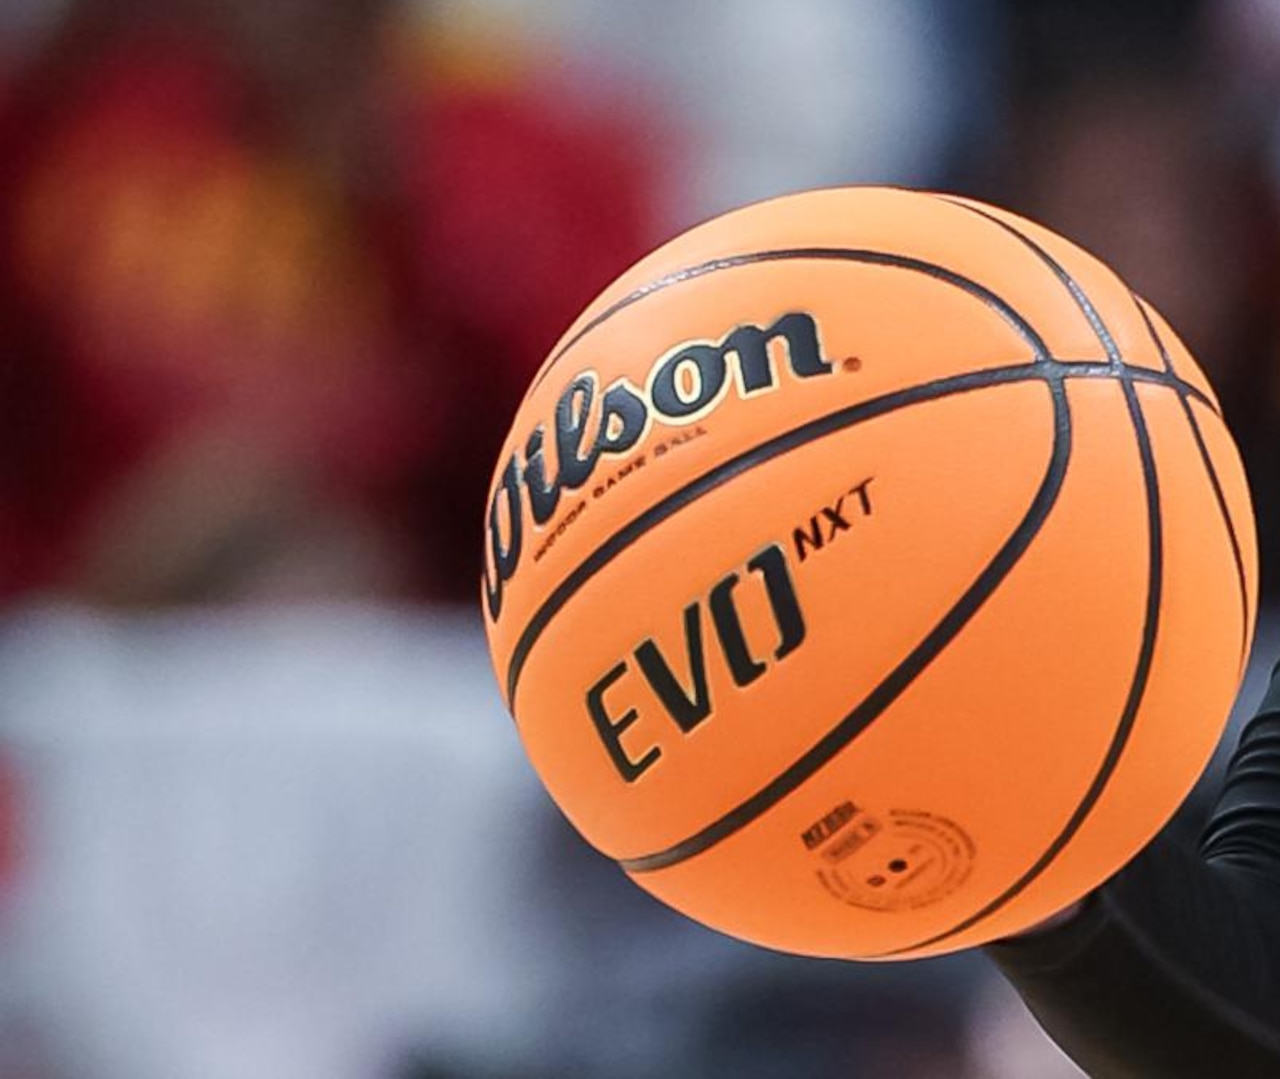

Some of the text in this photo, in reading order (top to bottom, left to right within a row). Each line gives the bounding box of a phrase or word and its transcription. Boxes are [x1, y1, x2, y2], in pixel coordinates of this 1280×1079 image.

[482, 308, 836, 625] Wilson
[592, 456, 646, 499] GAME
[653, 426, 708, 458] BALL
[585, 475, 875, 784] EVO NXT
